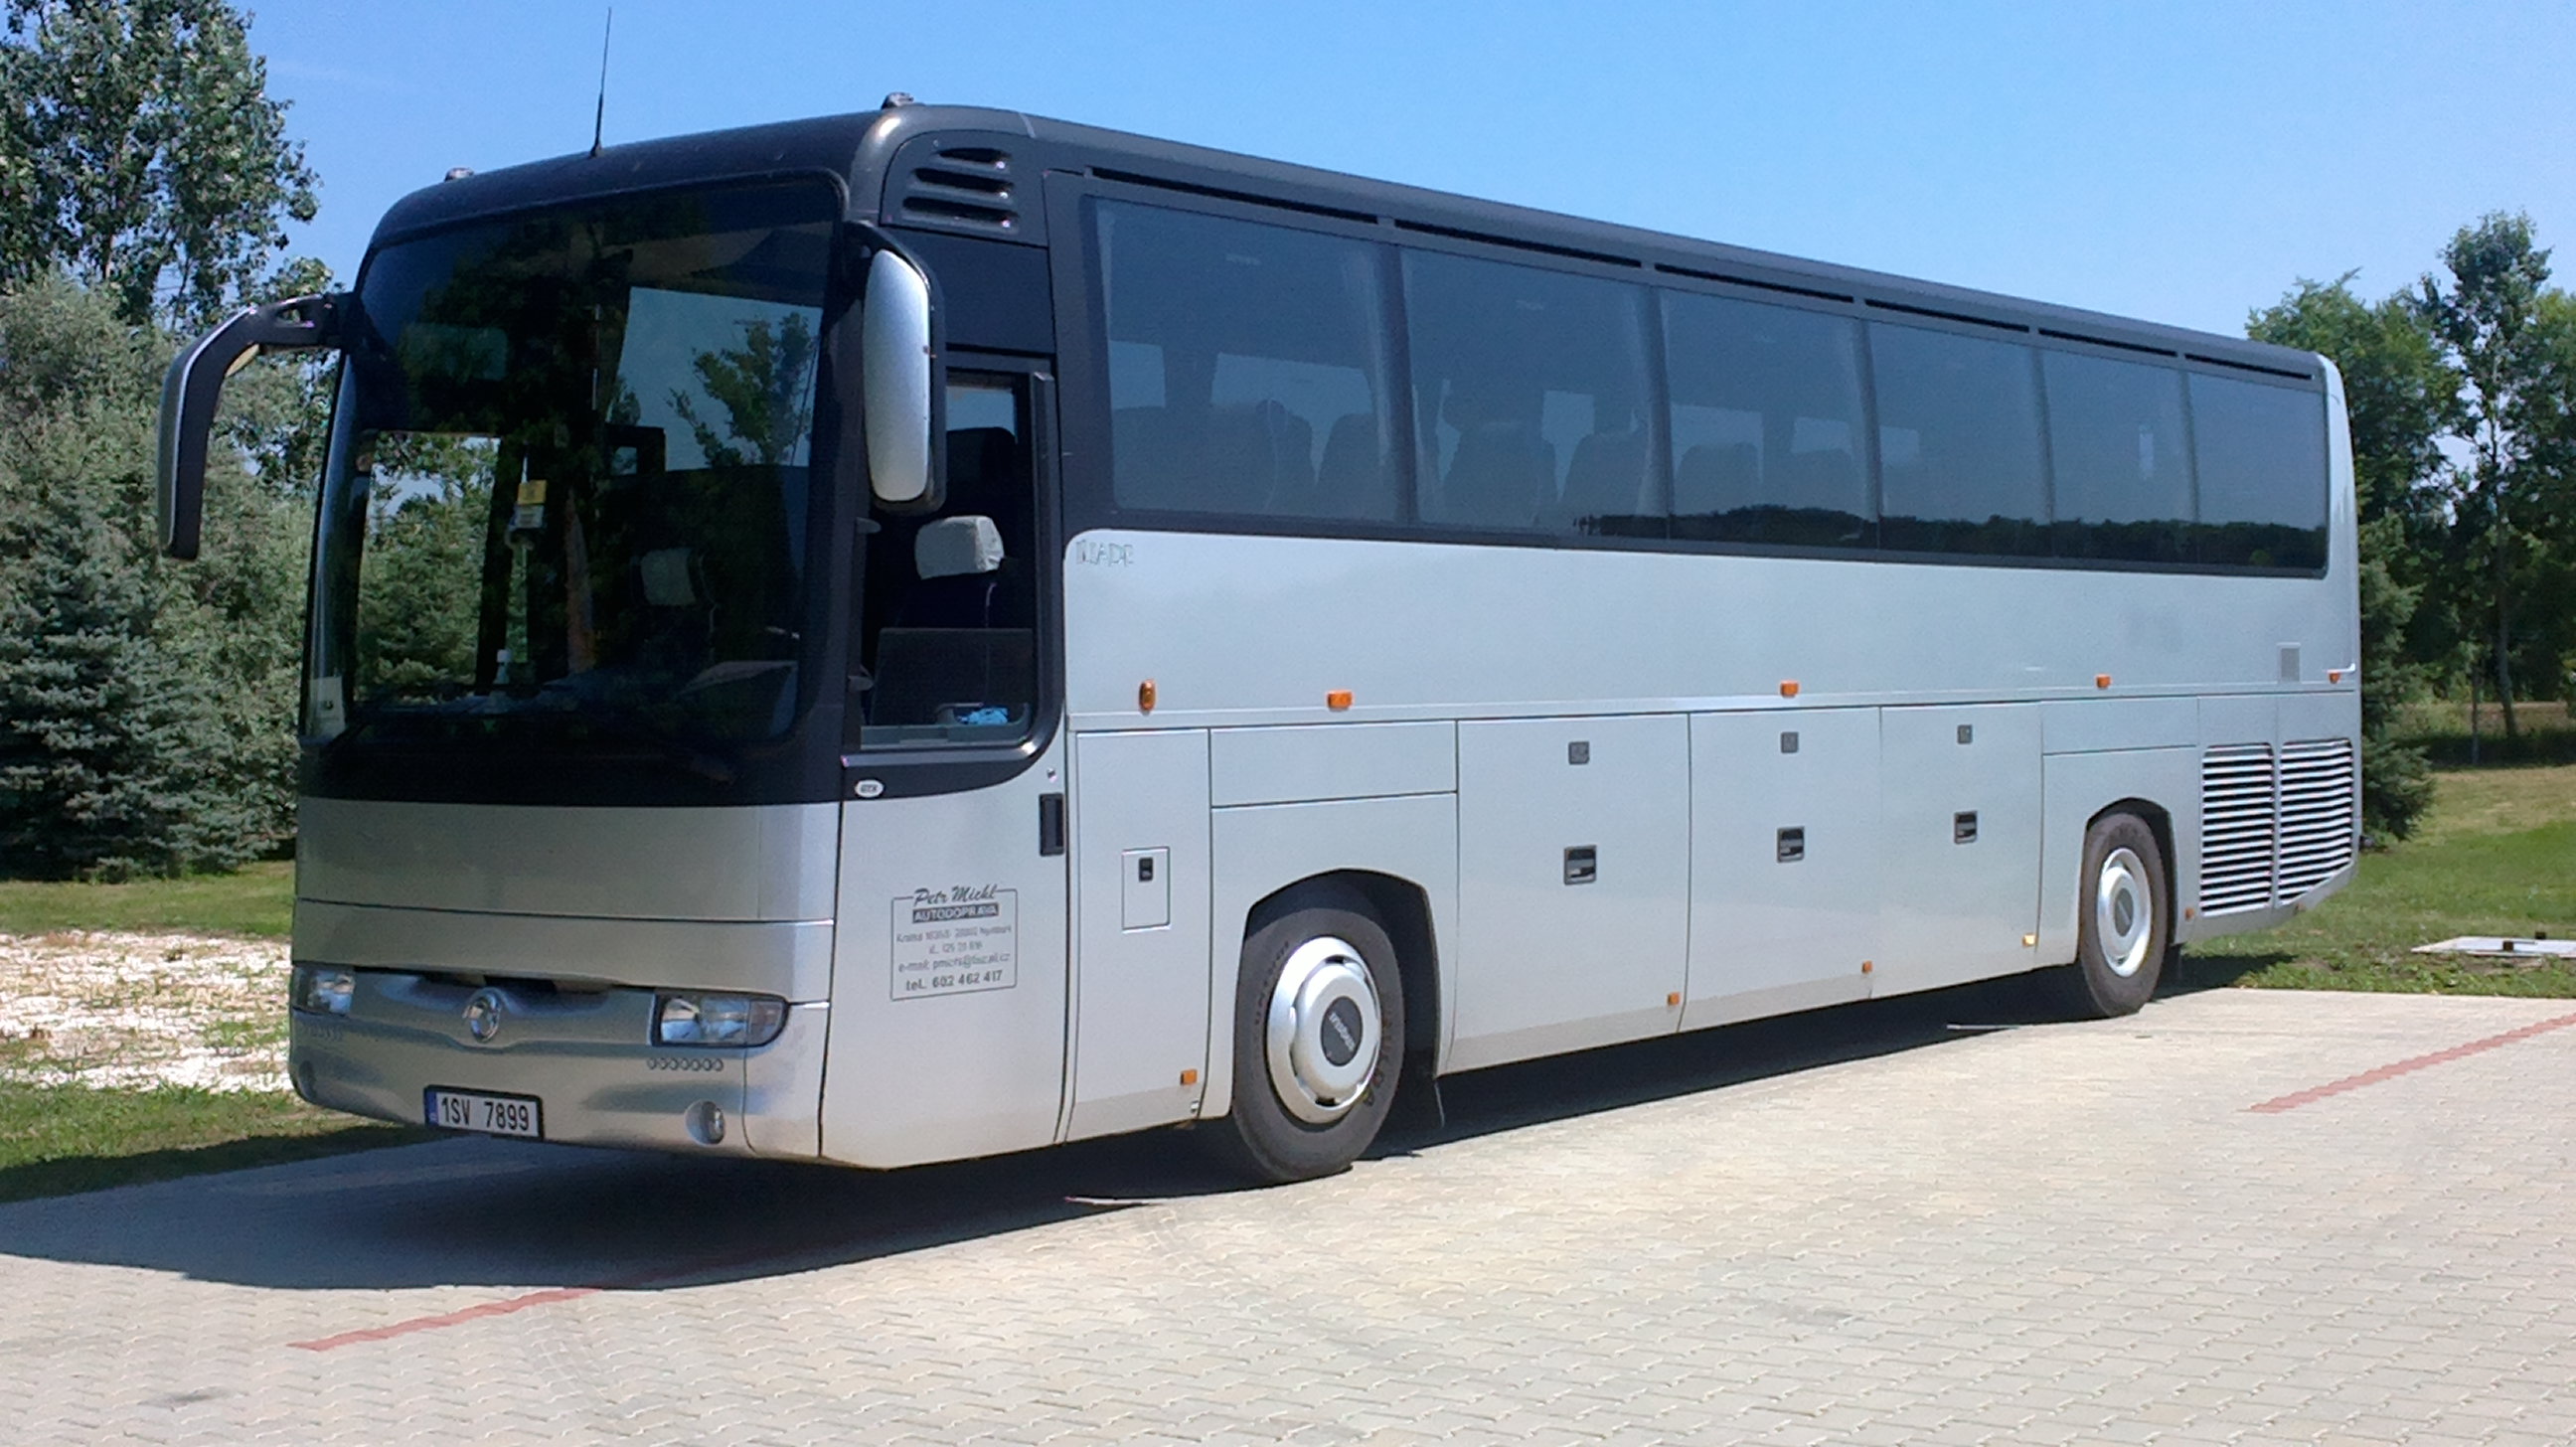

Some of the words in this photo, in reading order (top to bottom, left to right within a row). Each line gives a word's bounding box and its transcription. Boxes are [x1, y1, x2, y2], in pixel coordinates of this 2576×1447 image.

[914, 887, 947, 906] Petr
[913, 904, 998, 922] AUTODOPRAVA
[932, 975, 955, 989] 602
[958, 973, 980, 986] 462
[984, 970, 1003, 983] 417
[441, 1096, 471, 1126] 1SV
[484, 1100, 530, 1132] 7899
